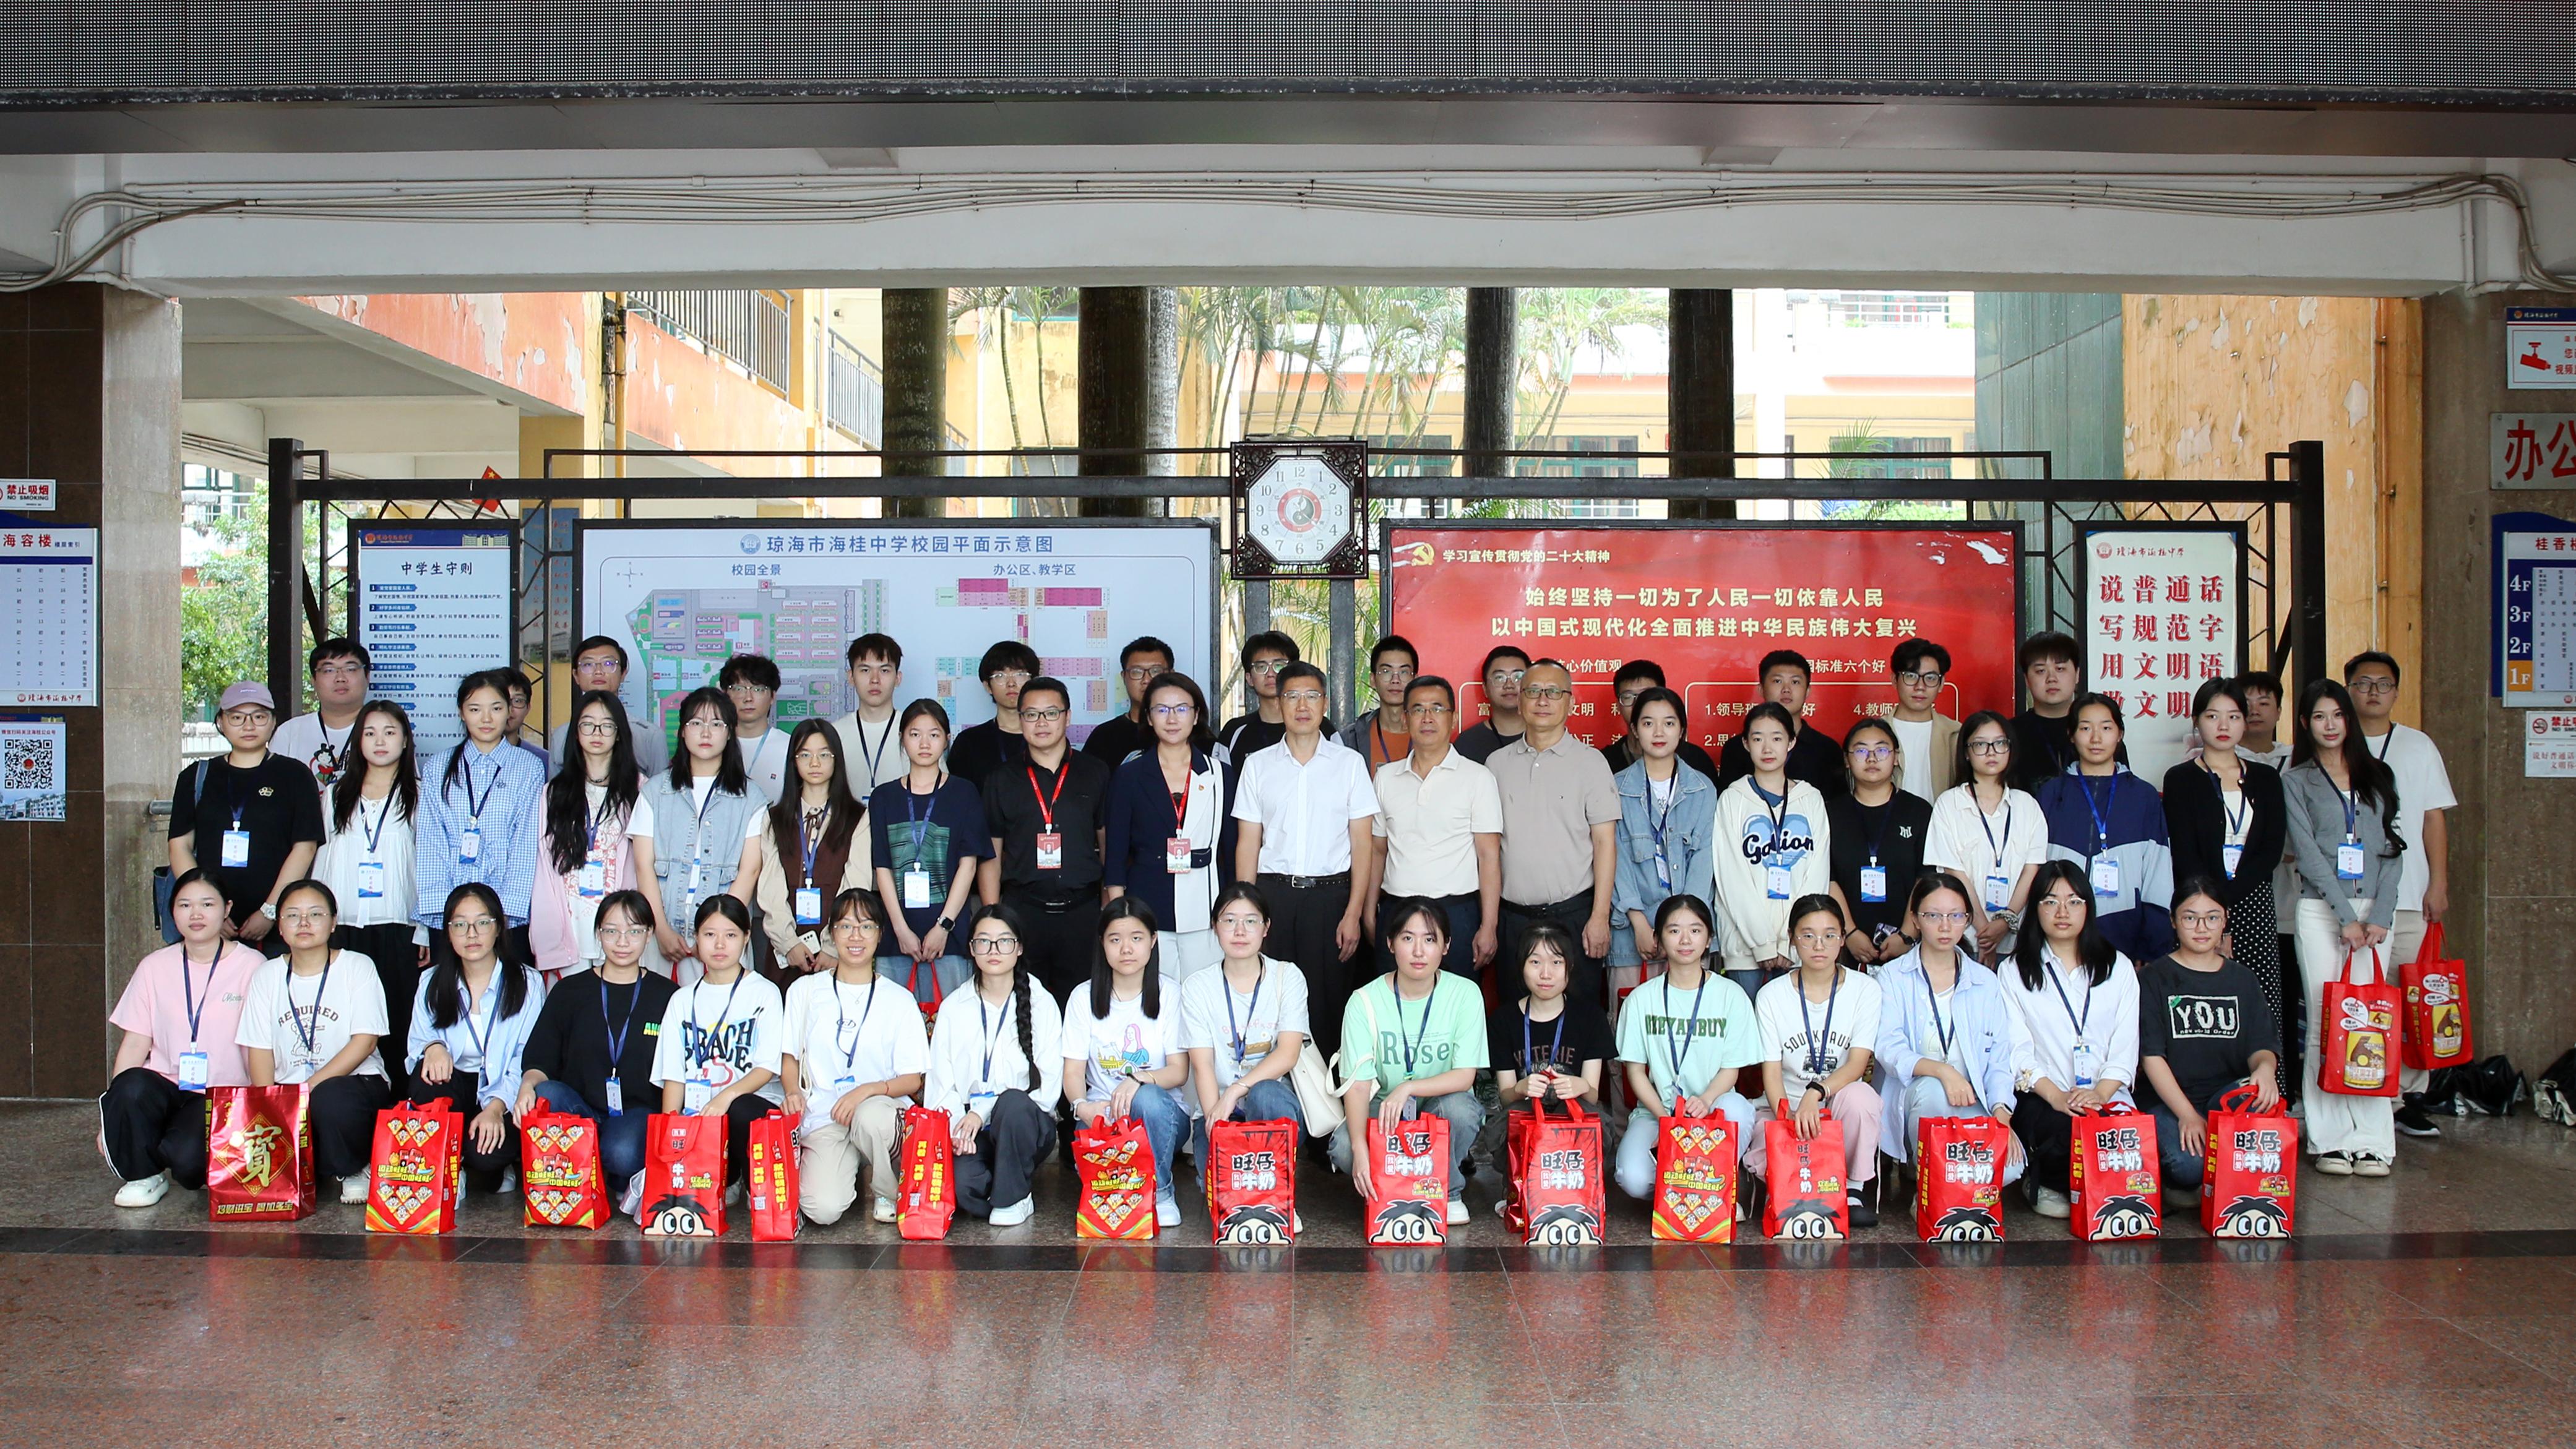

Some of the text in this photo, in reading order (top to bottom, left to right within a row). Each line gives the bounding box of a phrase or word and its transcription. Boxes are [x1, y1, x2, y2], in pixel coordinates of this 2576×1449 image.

[1277, 471, 1285, 482] 11
[1294, 467, 1306, 478] 12
[1319, 471, 1323, 482] 1
[7, 484, 50, 495] 禁止吸烟
[1261, 485, 1272, 493] 10
[1329, 483, 1337, 495] 2
[1256, 505, 1264, 517] 9
[1334, 504, 1343, 516] 3
[1261, 525, 1269, 536] 8
[1329, 525, 1337, 536] 4
[3, 534, 51, 548] 海容楼
[767, 535, 1053, 553] 琼海市海桂中学校园平面示意图
[1275, 540, 1284, 551] 7
[1316, 540, 1324, 551] 5
[1296, 543, 1304, 555] 6
[1442, 549, 1610, 563] 学习宣传贯彻党的二十大精神
[401, 561, 472, 575] 中学生守则
[731, 564, 782, 576] 校园全景
[993, 564, 1076, 576] 办公区、教学区
[2100, 575, 2225, 604] 说普通话
[2509, 574, 2531, 592] 4F
[1525, 587, 1884, 608] 始终坚持一切为了人民一切依靠人民
[2509, 606, 2531, 623] 3F
[1491, 617, 1916, 638] 以中国式现代化全面推进中华民族伟大复兴
[2100, 613, 2224, 642] 写规范字
[2509, 637, 2531, 655] 2F
[2100, 652, 2225, 681] 用文明语
[2509, 668, 2531, 685] 1F
[2176, 1001, 2236, 1031] YOU
[1381, 1031, 1450, 1065] Rose
[2096, 1128, 2140, 1150] 旺仔
[2234, 1130, 2281, 1152] 旺仔
[1233, 1152, 1275, 1171] 旺仔
[1541, 1150, 1585, 1170] 旺仔
